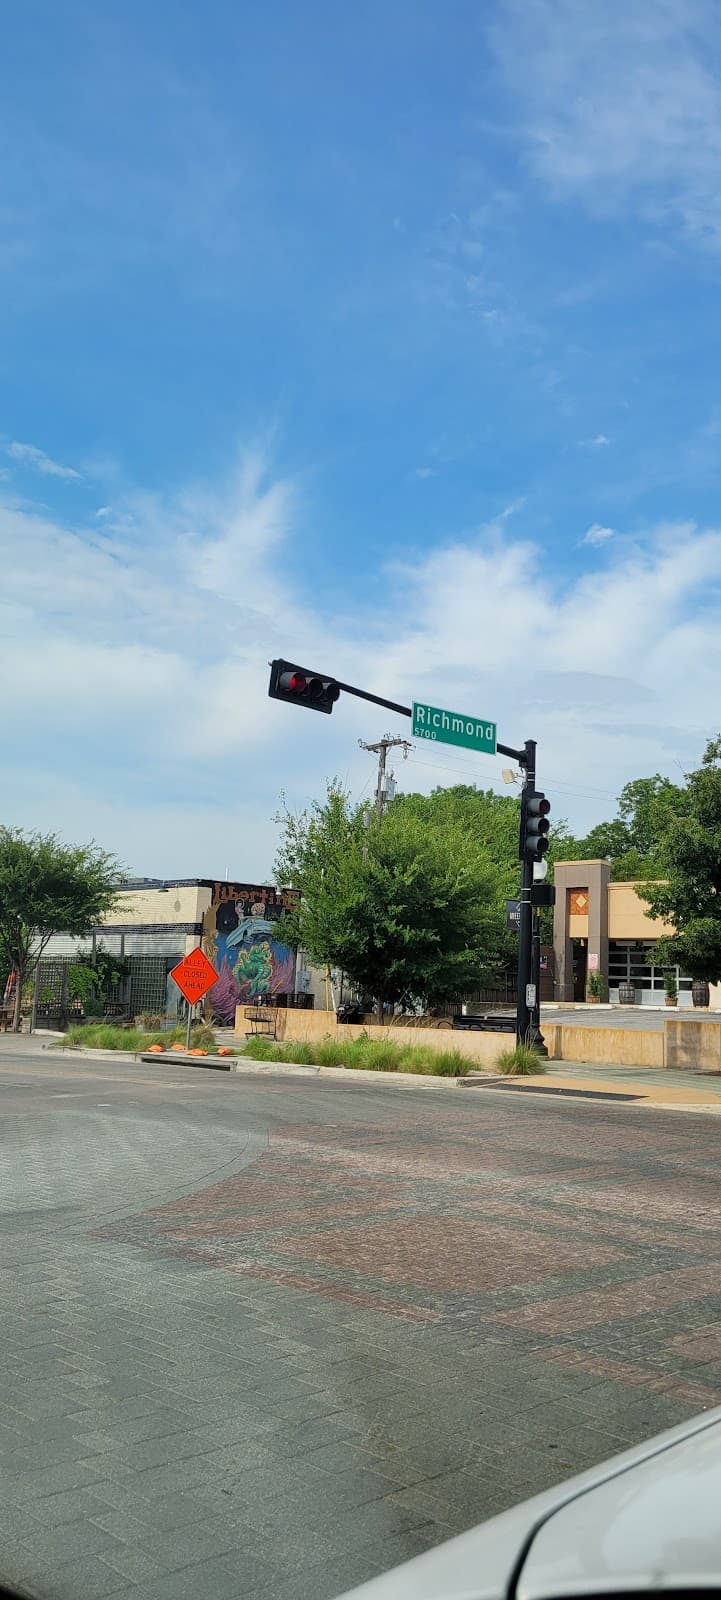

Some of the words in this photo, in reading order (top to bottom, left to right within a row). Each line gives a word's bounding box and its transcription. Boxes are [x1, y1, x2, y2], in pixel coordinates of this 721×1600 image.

[416, 706, 493, 740] Richmond
[414, 727, 437, 740] 5700
[184, 958, 205, 968] ALLEY
[184, 970, 207, 979] CLOSED
[184, 981, 205, 990] AHEAD
